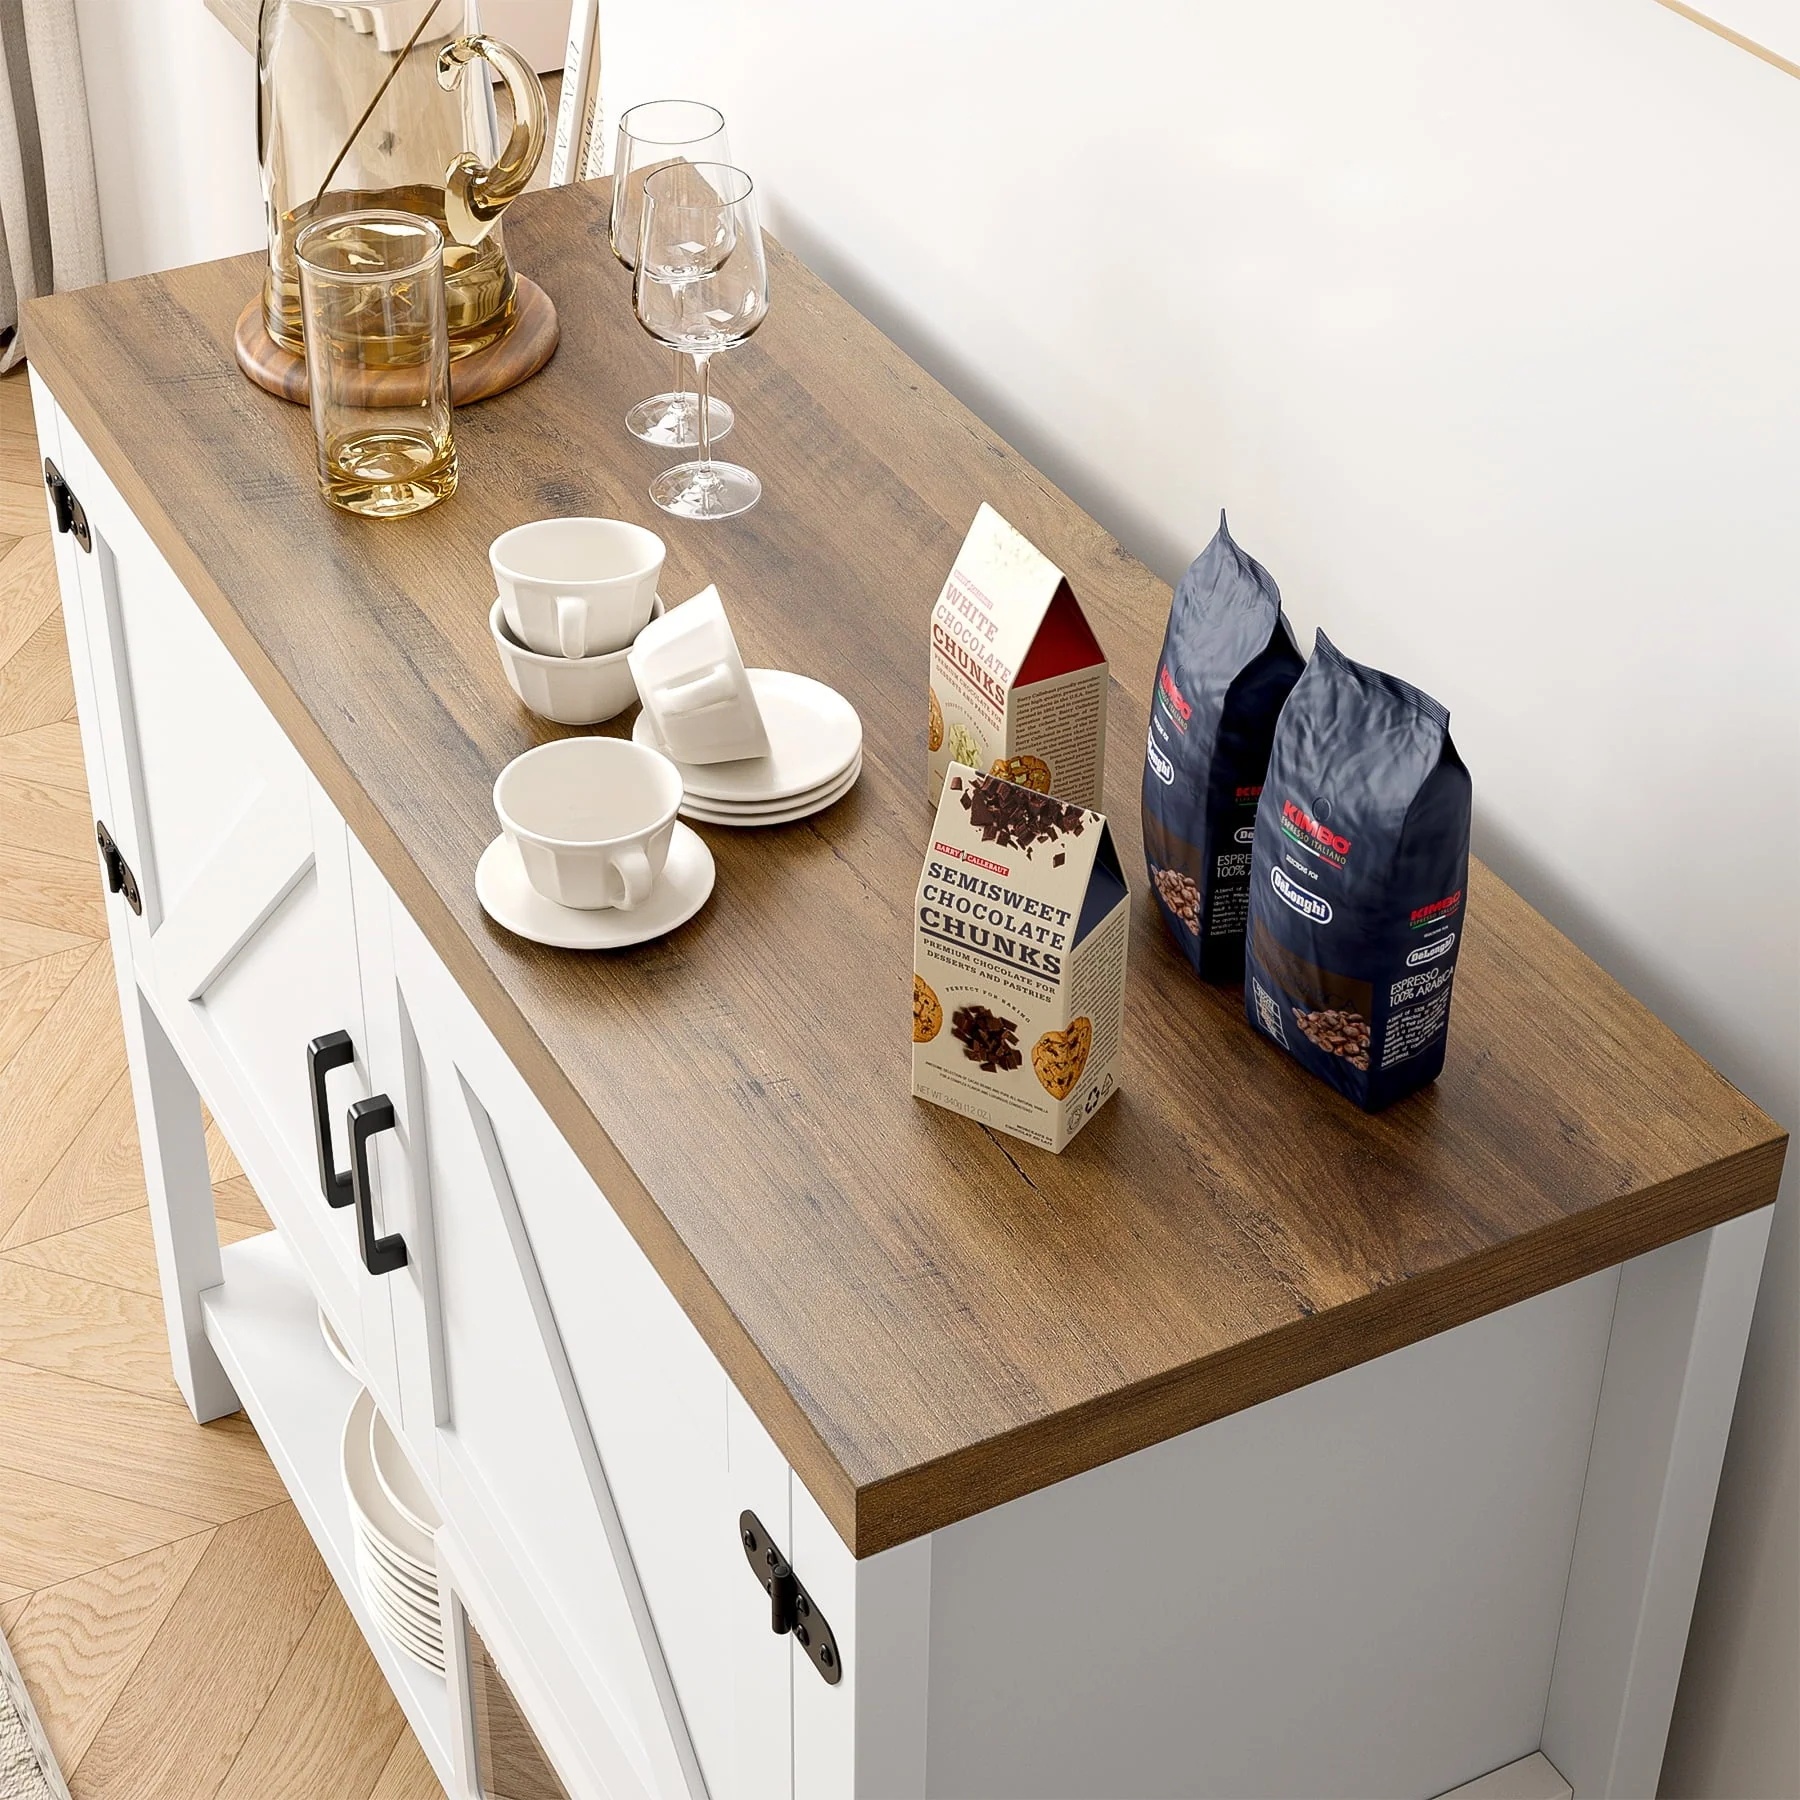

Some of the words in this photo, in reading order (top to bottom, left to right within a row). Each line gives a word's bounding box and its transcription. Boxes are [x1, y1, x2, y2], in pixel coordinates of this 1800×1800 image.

[946, 582, 998, 643] WHITE
[933, 623, 1005, 706] CHUNKS
[936, 604, 1012, 683] CHOCOLATE
[1281, 815, 1309, 843] ESPRESSO
[1311, 838, 1347, 865] ITALIANO
[1283, 800, 1350, 854] KIMBO
[935, 842, 961, 858] BARRY
[966, 853, 1009, 876] CALLEBAUT
[1217, 853, 1252, 866] ESPRE
[1217, 865, 1245, 878] 100%
[923, 884, 1066, 951] CHOCOLATE
[928, 862, 1071, 927] SEMISWEET
[1411, 890, 1461, 921] KIMBO
[920, 906, 1061, 975] CHUNKS
[923, 938, 970, 961] PREMIUM
[973, 958, 1033, 986] CHOCOLATE
[1036, 982, 1056, 995] FOR
[927, 949, 976, 974] DESSERTS
[979, 970, 1001, 983] AND
[1003, 980, 1052, 1003] PASTRIES
[1390, 967, 1439, 996] ESPRESSO
[1390, 988, 1414, 1008] 100%
[945, 985, 979, 993] PERFECT
[982, 989, 998, 1000] FOR
[1001, 999, 1031, 1024] BAKING
